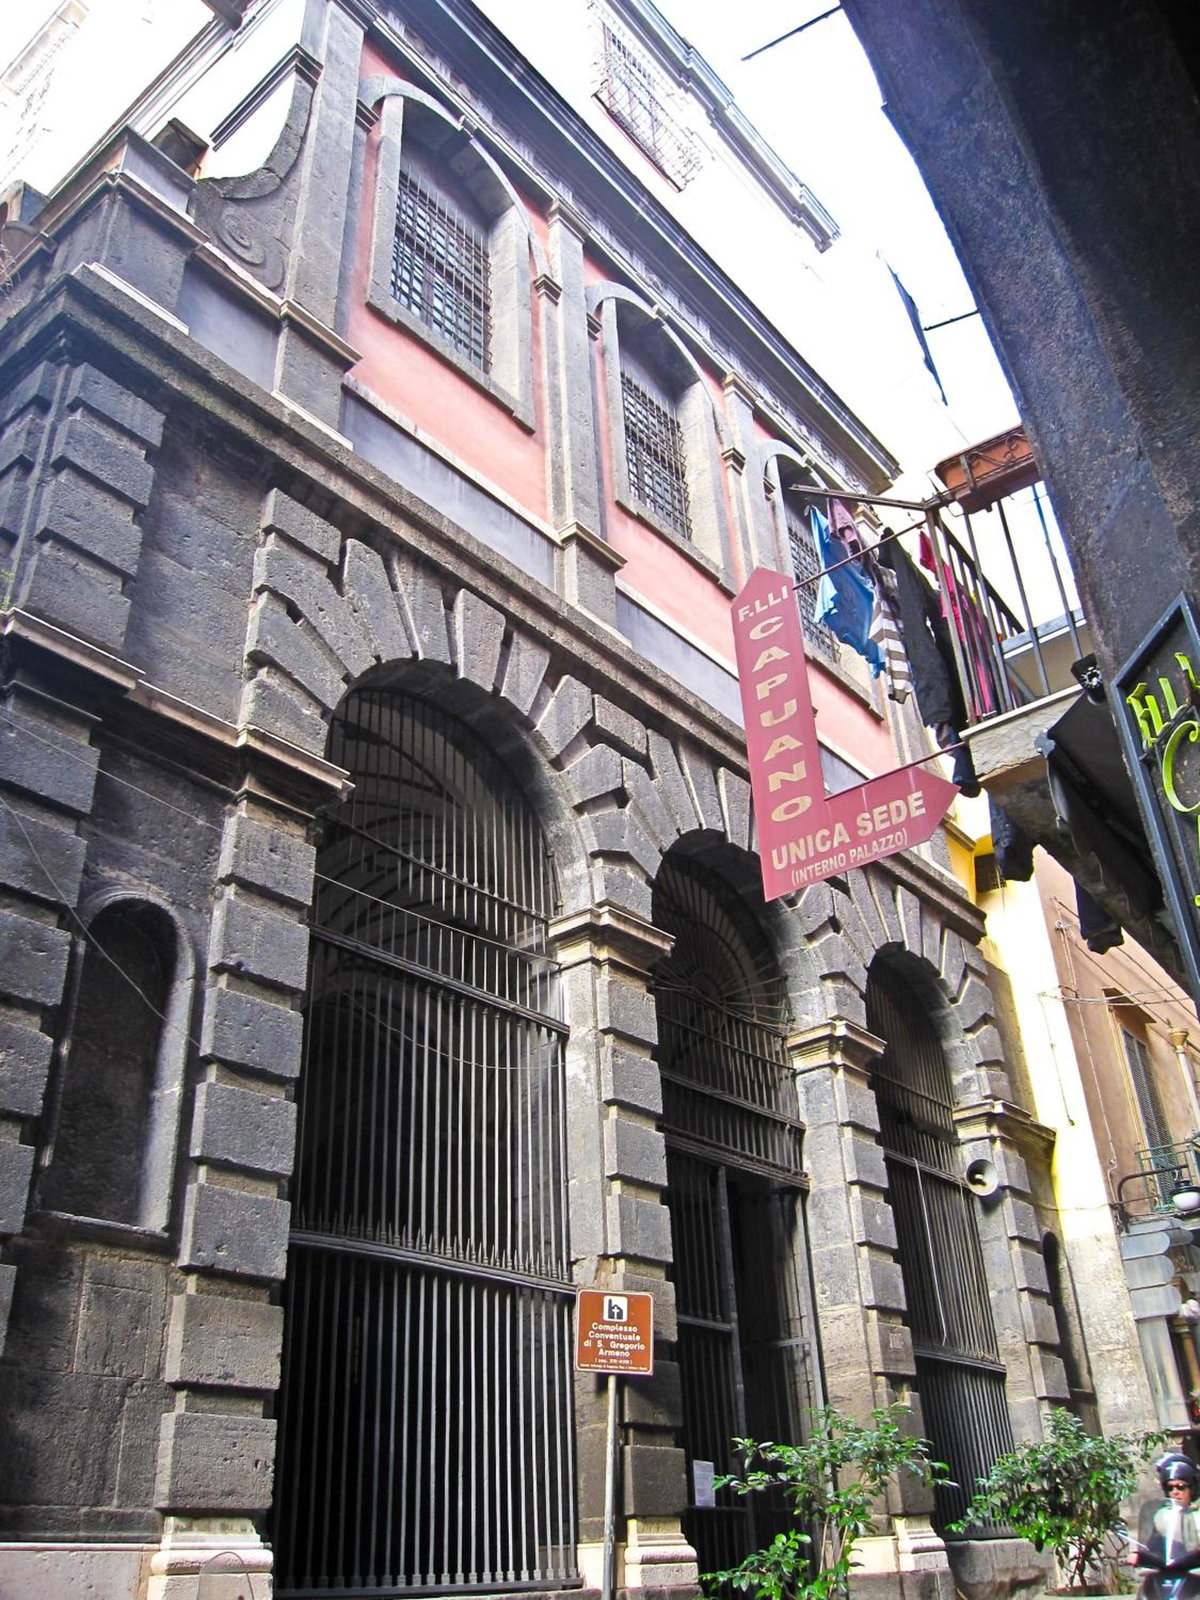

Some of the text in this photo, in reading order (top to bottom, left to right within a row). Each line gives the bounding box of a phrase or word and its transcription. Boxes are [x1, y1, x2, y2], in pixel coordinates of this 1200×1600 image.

[738, 586, 789, 622] F.LLI
[749, 616, 812, 822] CAPUANO
[771, 791, 926, 870] UNICA SEDE
[791, 827, 908, 886] (INTERNO PALAZZO)
[588, 1331, 641, 1341] Conventuale
[592, 1322, 638, 1333] Complesso
[598, 1348, 630, 1357] Armeno
[609, 1341, 645, 1351] Gregorio
